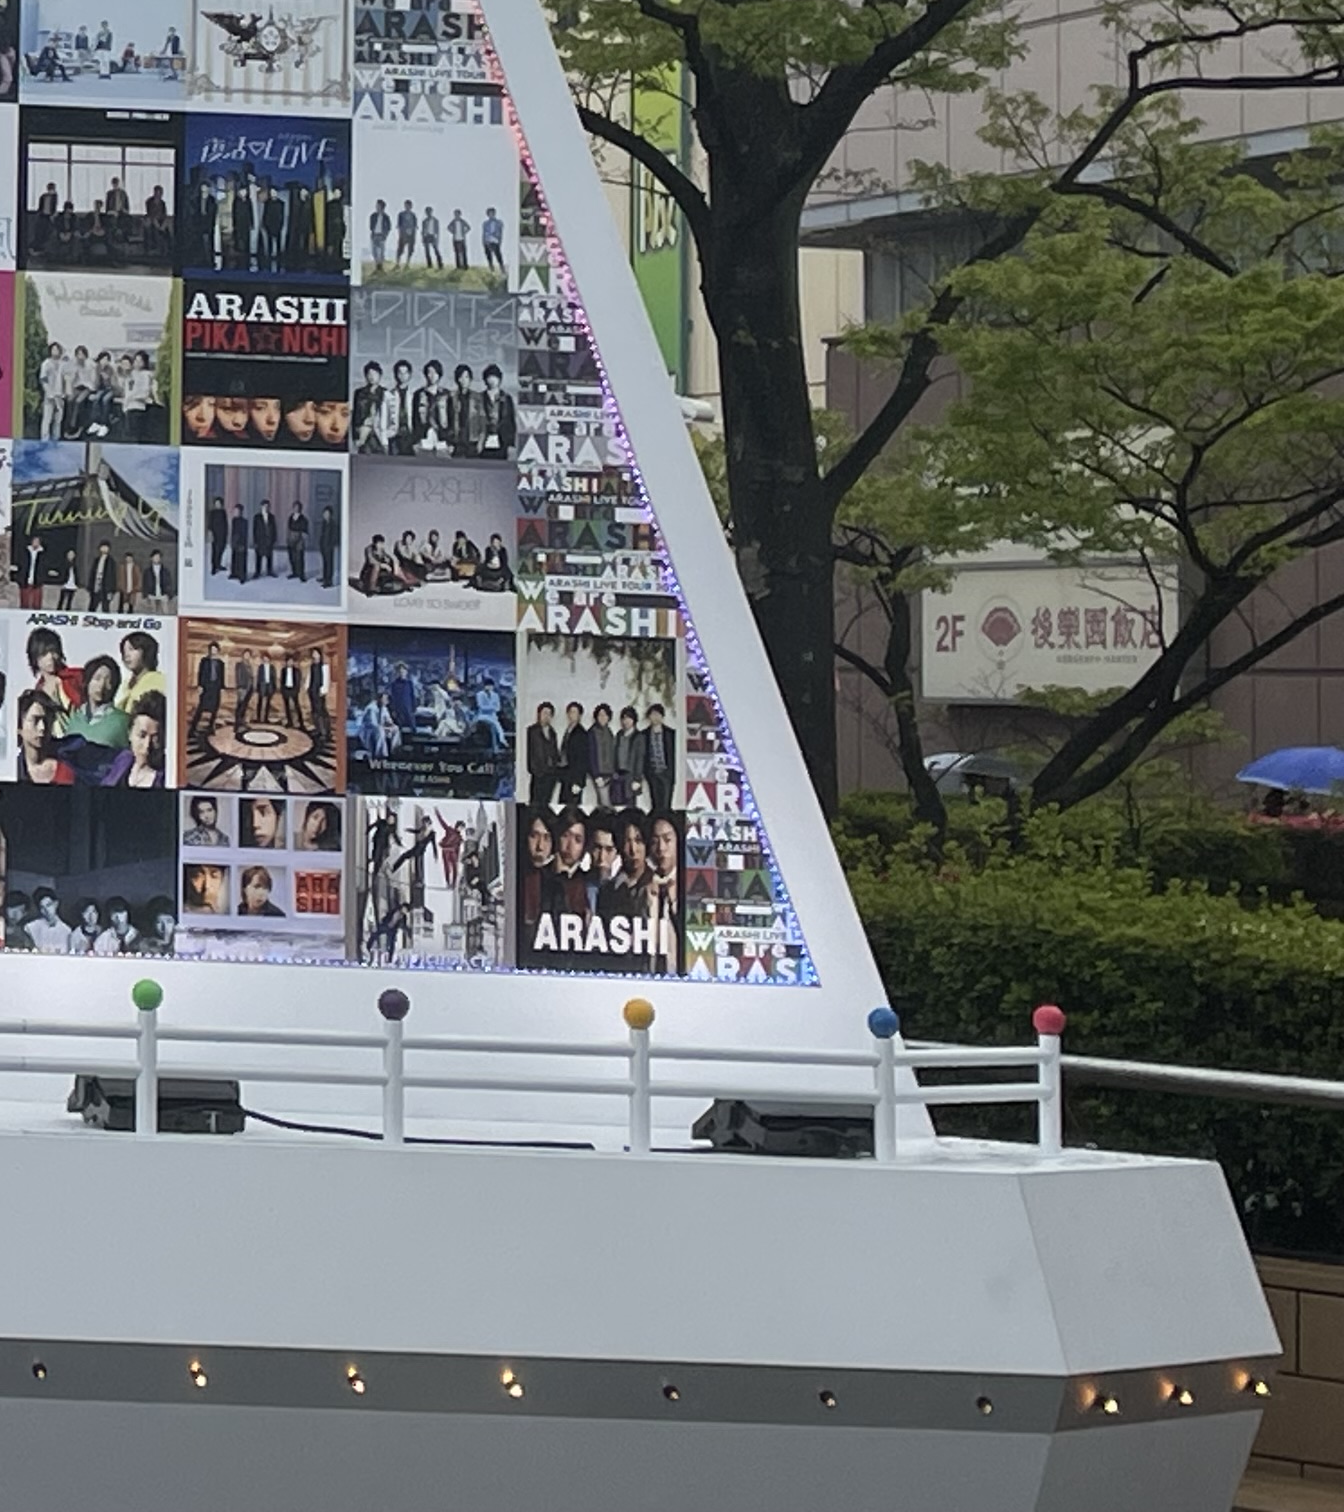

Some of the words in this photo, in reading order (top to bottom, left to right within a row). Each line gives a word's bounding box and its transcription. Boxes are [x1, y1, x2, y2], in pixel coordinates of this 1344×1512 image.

[186, 292, 348, 325] ARASHI
[518, 477, 598, 494] ARASHI
[573, 590, 617, 607] are
[27, 612, 79, 627] ARASHI
[116, 617, 142, 630] and
[143, 618, 162, 631] Go
[518, 604, 679, 638] ARASHI
[935, 614, 966, 653] 2F
[369, 758, 434, 773] Whenever
[437, 760, 464, 774] You
[466, 762, 495, 775] Call
[533, 913, 668, 956] ARASHI
